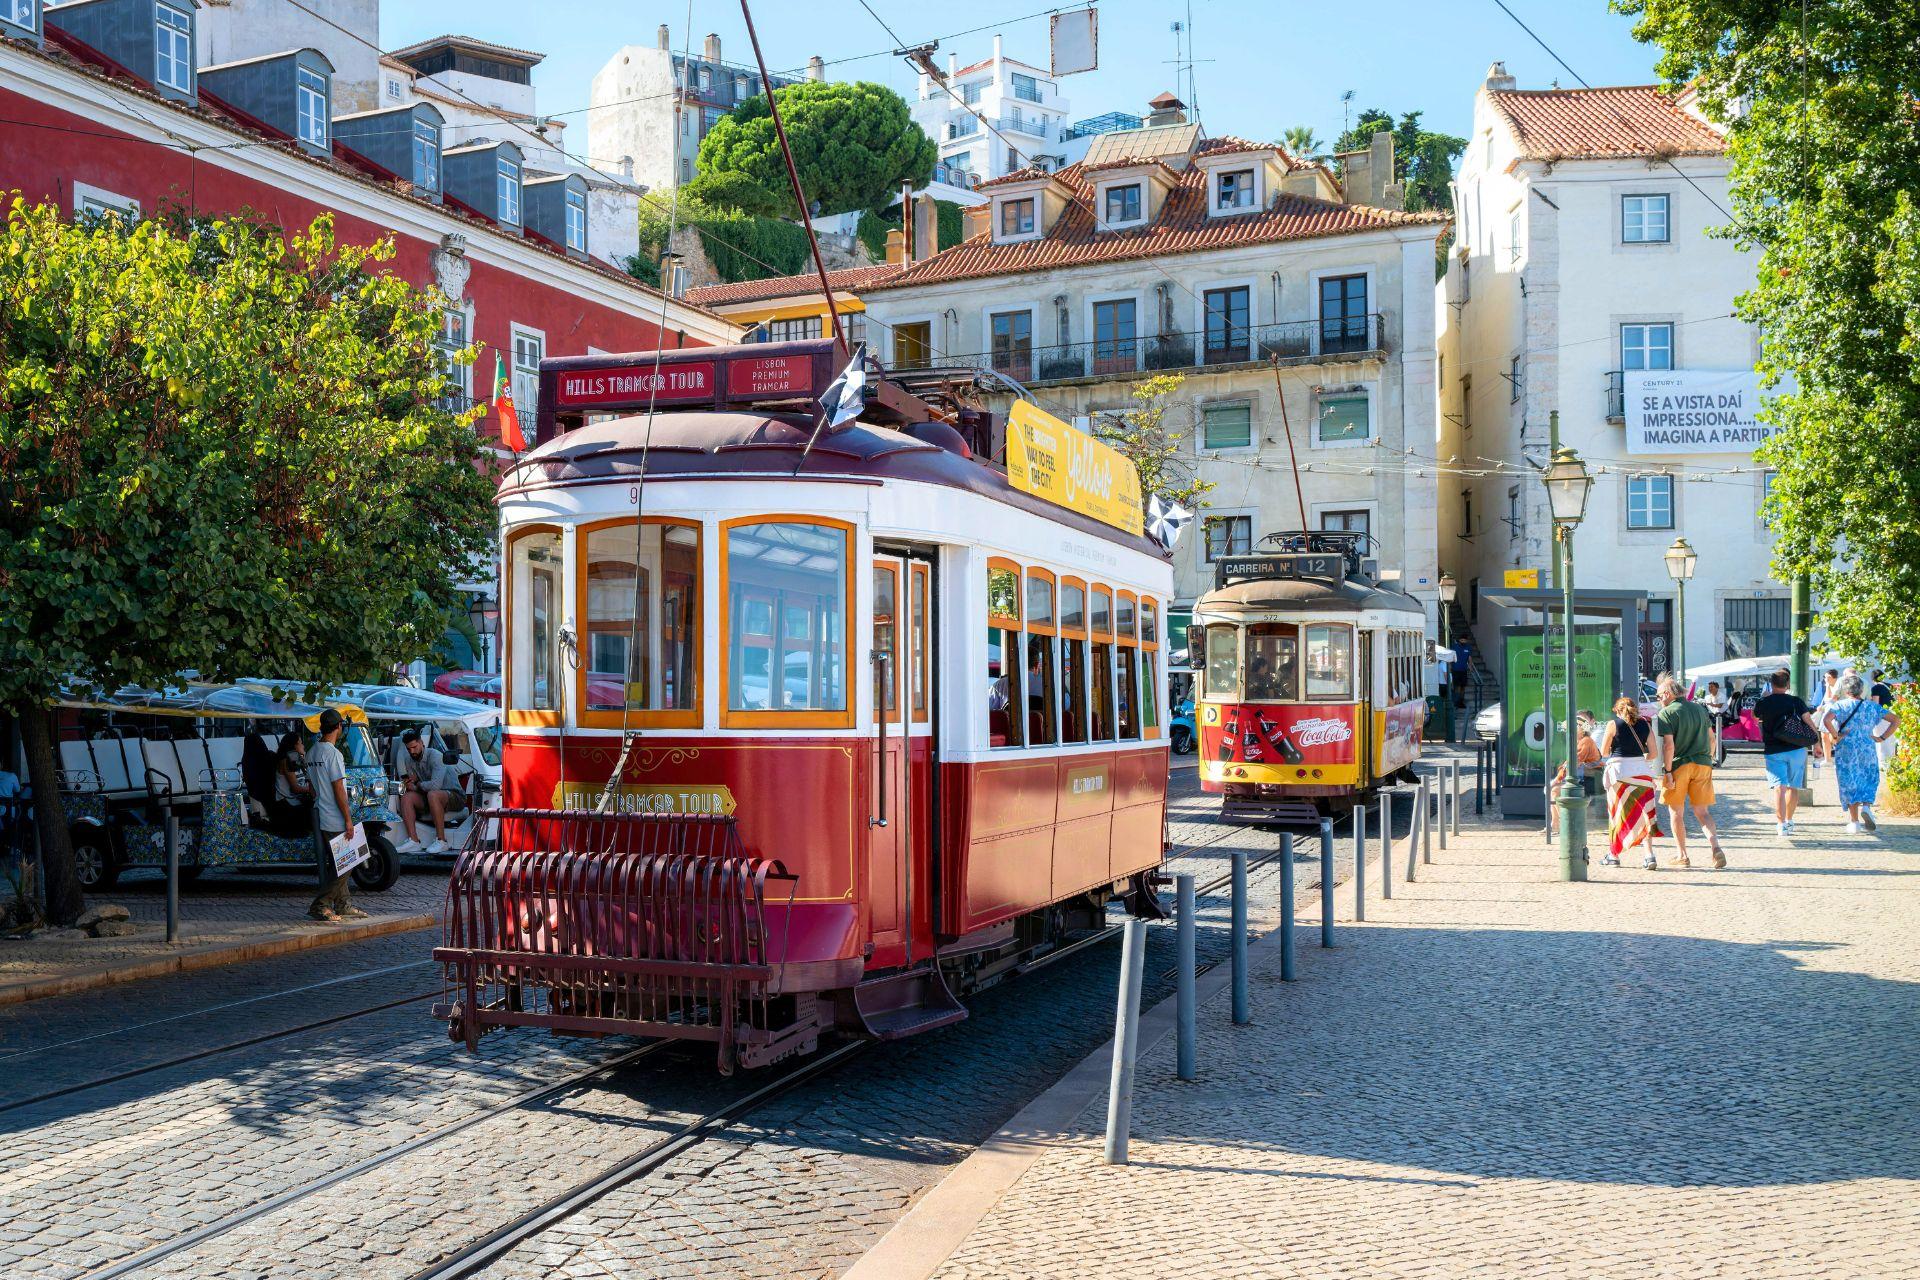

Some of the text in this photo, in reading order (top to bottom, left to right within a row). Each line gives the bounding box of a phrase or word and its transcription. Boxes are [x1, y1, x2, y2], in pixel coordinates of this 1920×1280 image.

[756, 359, 786, 369] LISBON
[752, 370, 790, 380] PREMIUM
[566, 371, 704, 396] HILLS TRAMCAR TOUR
[752, 381, 789, 392] TRAMCAR
[1643, 390, 1743, 411] SE A VISTA DAÍ
[1024, 423, 1034, 442] THE
[1644, 429, 1706, 444] IMAGINA
[1709, 429, 1720, 443] A
[630, 487, 638, 505] 9
[1225, 563, 1275, 574] CARREIRA
[1307, 559, 1326, 572] 12
[679, 793, 723, 813] TOUR
